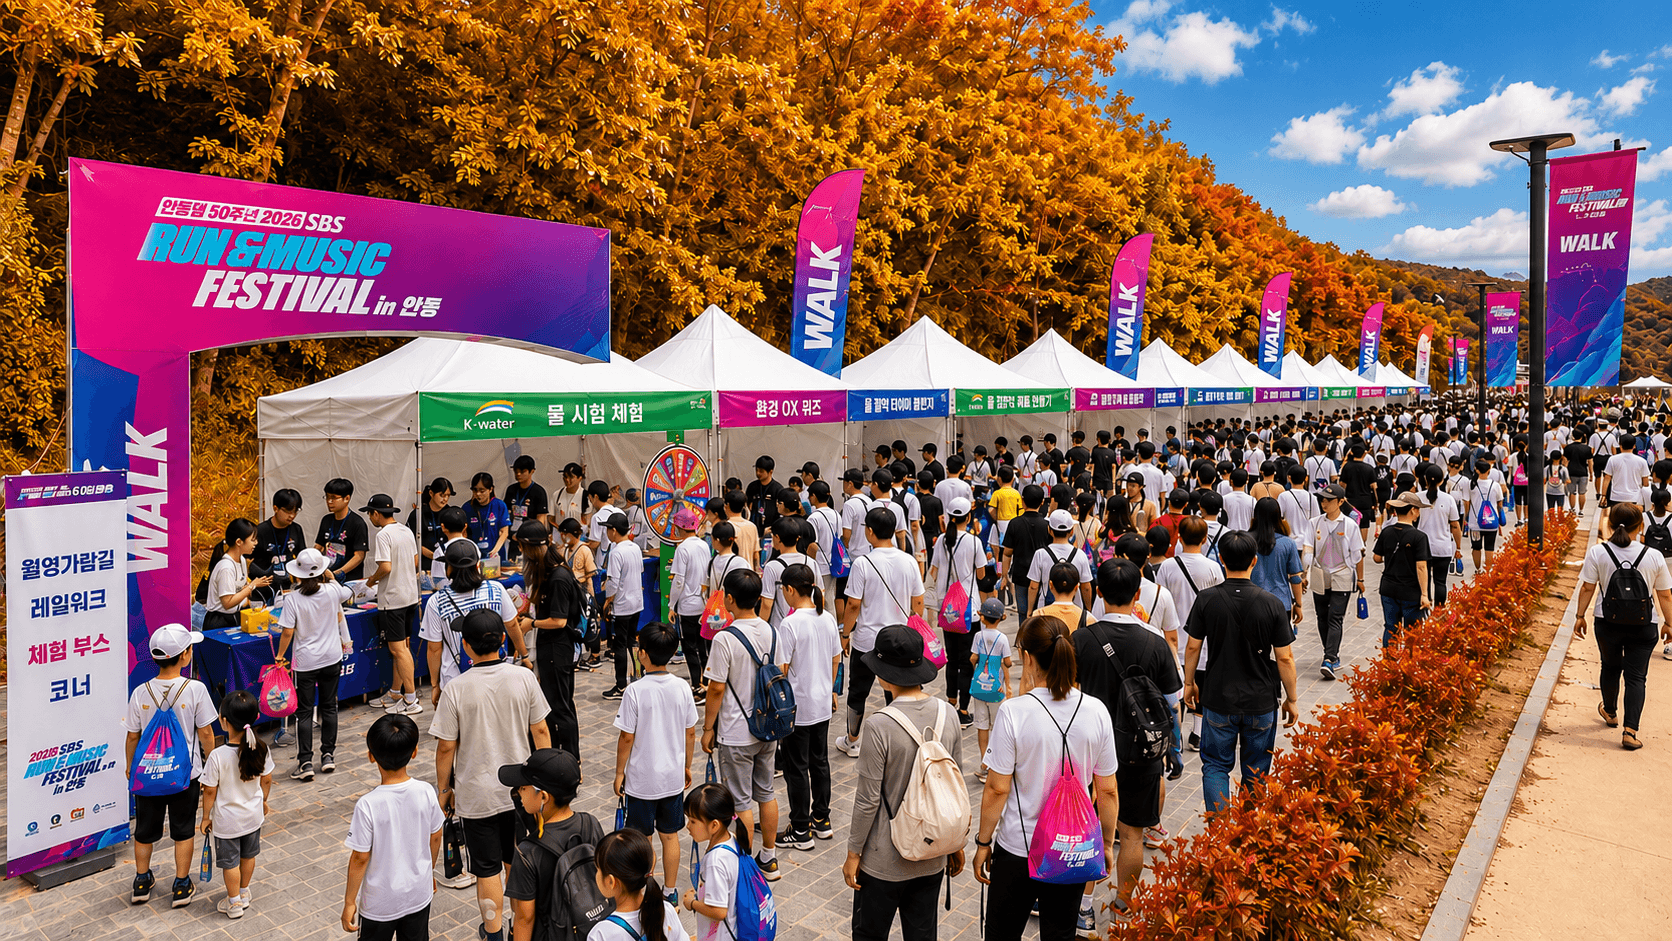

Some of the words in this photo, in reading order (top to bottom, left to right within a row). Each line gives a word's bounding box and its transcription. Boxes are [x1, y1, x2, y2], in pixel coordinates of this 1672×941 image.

[162, 199, 206, 218] 안동댐
[207, 205, 259, 223] 50주년
[260, 210, 303, 227] 2026
[305, 213, 346, 233] SBS
[1560, 231, 1619, 253] WALK
[192, 269, 375, 315] FESTIVAL
[373, 295, 397, 316] in
[399, 296, 443, 318] 안동
[804, 241, 842, 349] WALK
[1115, 282, 1139, 356] WALK
[1491, 326, 1514, 334] WALK
[1264, 308, 1281, 363] WALK
[547, 404, 565, 426] 물
[571, 403, 605, 425] 시험
[611, 402, 643, 424] 체험
[782, 400, 799, 416] OX
[463, 418, 515, 430] K-water
[124, 420, 168, 574] WALK
[21, 549, 115, 581] 월영가람길
[30, 588, 107, 618] 레일워크
[27, 639, 67, 665] 체험
[73, 633, 110, 657] 부스
[49, 673, 91, 702] 코너
[59, 740, 83, 755] SBS
[41, 758, 102, 787] FESTIVAL
[53, 784, 64, 795] in
